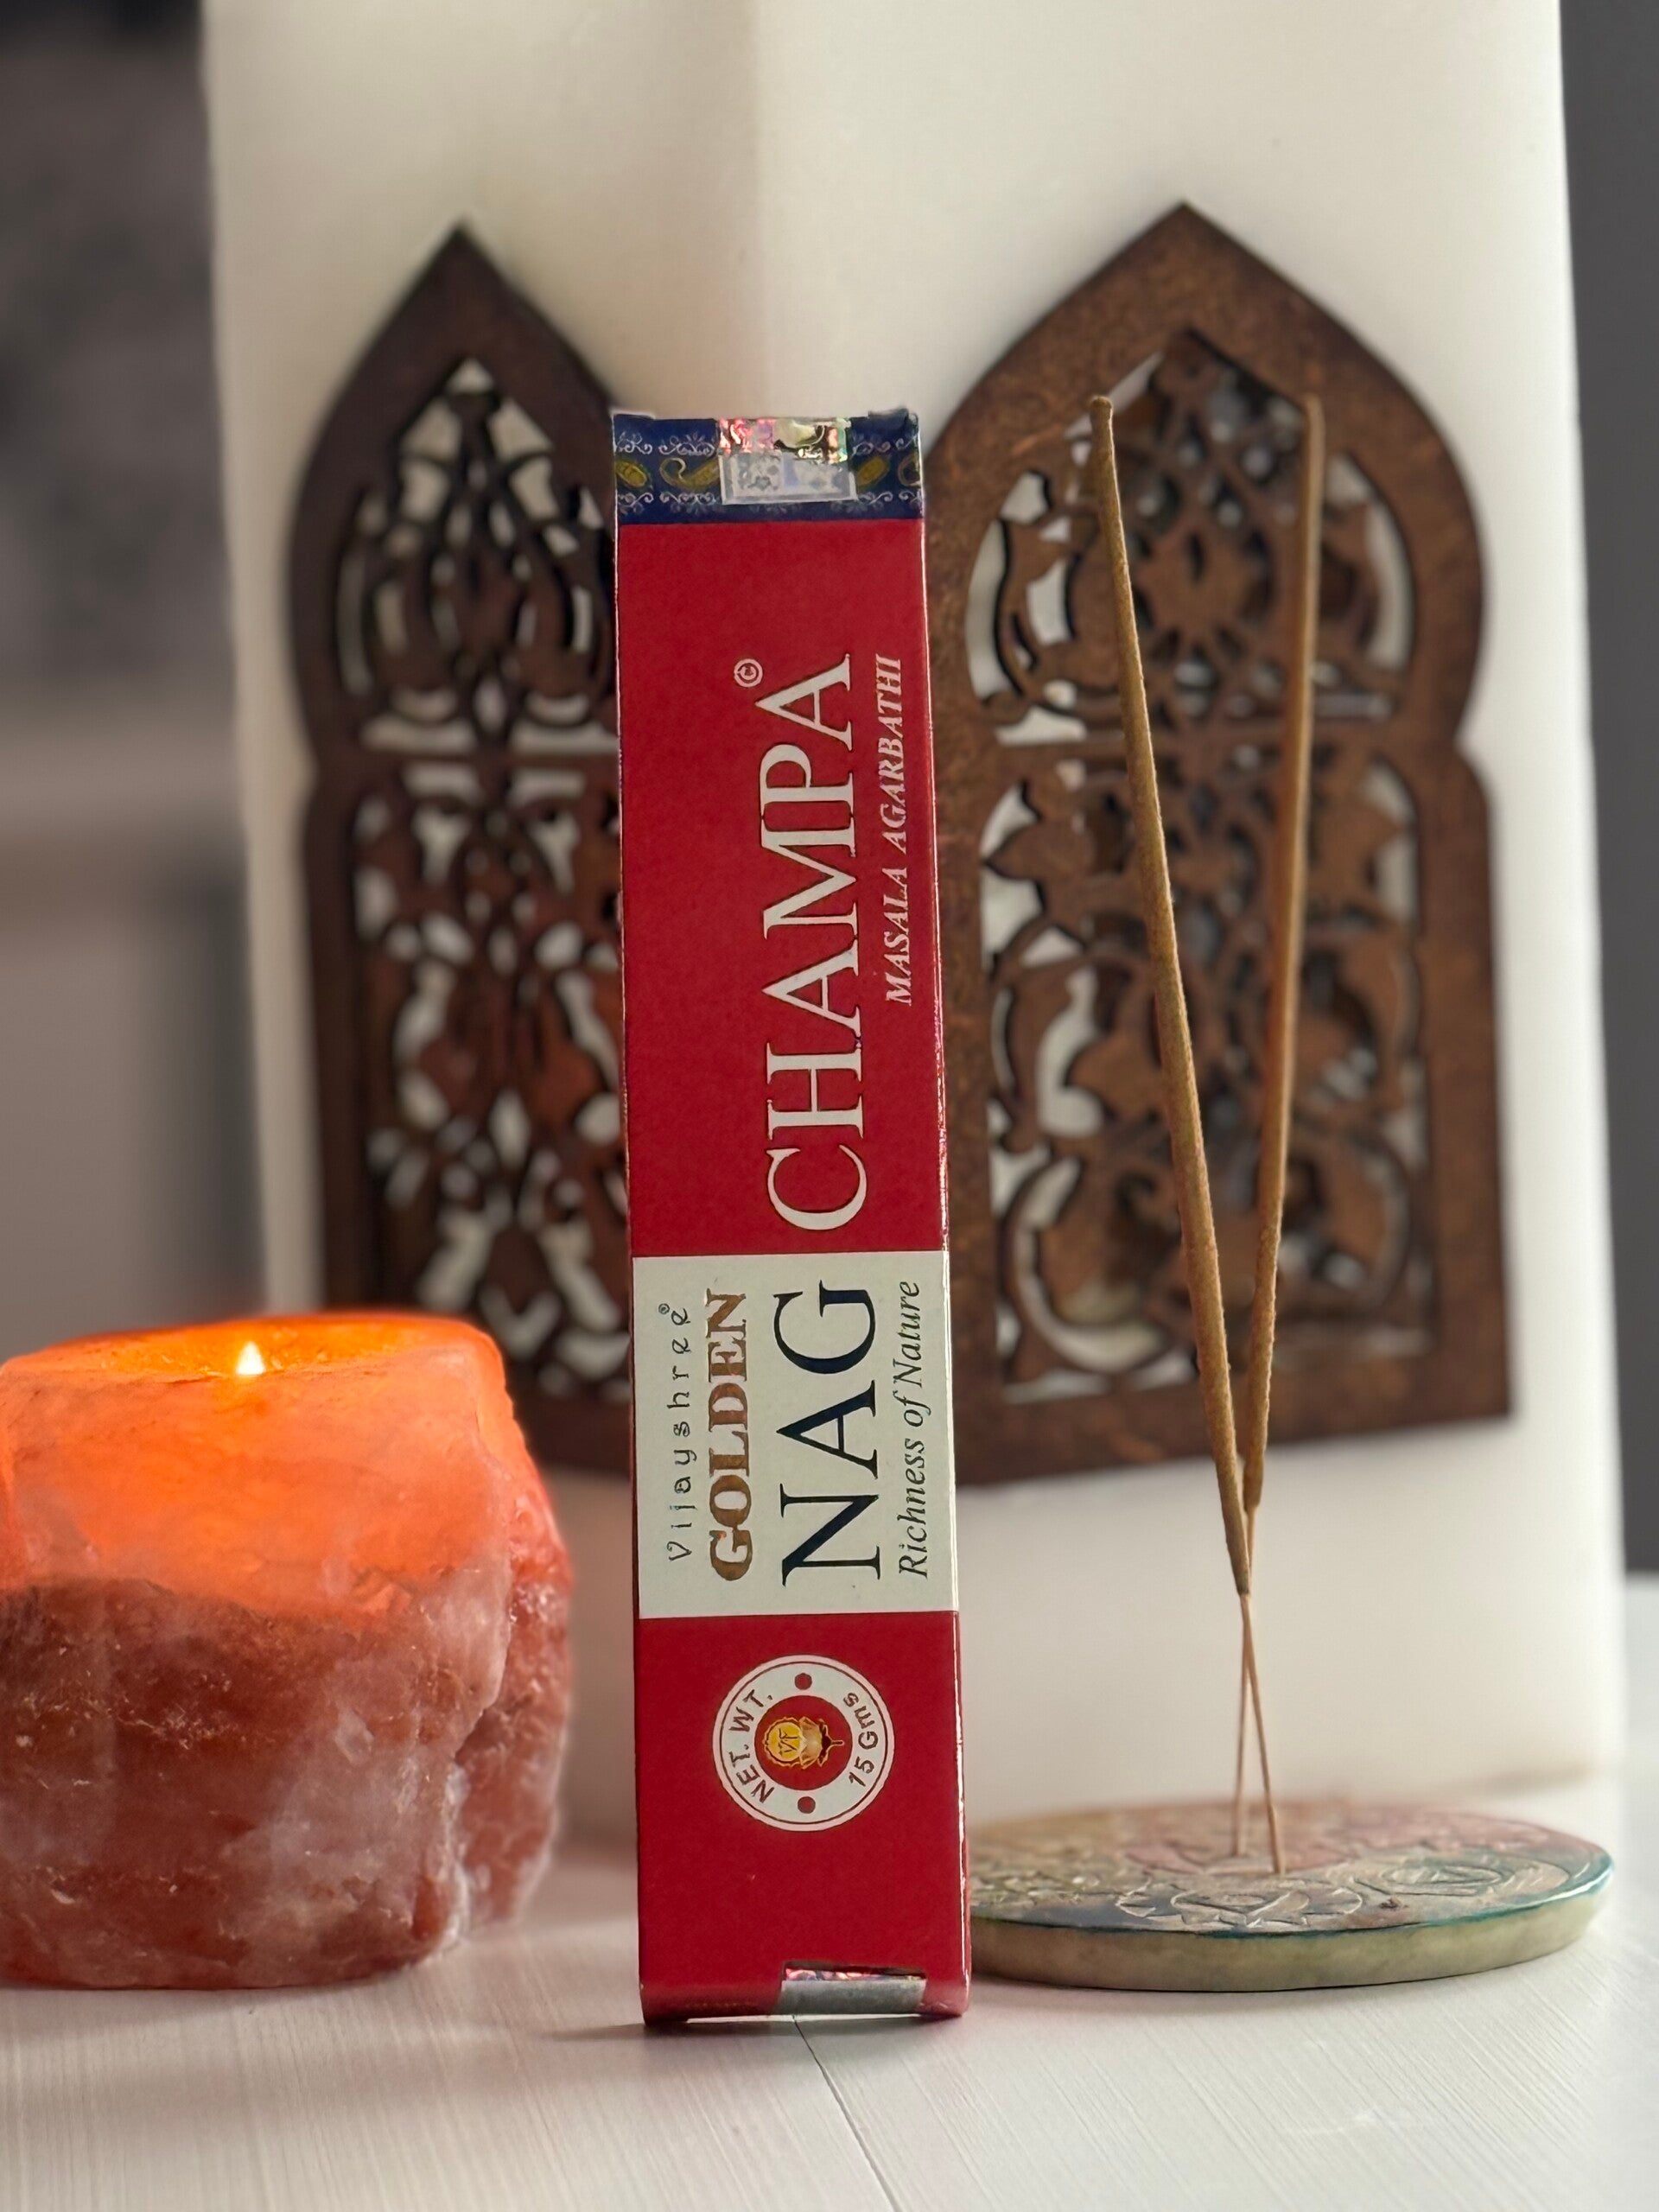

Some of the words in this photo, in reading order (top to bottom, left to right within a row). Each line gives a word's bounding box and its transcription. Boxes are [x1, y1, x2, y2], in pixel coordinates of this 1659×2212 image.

[874, 653, 908, 855] AGARBATHI
[883, 867, 912, 1007] MASALA
[893, 1281, 923, 1389] Nature
[704, 1287, 753, 1582] GOLDEN
[773, 1280, 880, 1586] NAG
[893, 1389, 931, 1427] of
[897, 1438, 928, 1579] Richness
[729, 1688, 773, 1733] WT.
[842, 1692, 879, 1750] Gms
[729, 1745, 775, 1803] NET.
[849, 1756, 874, 1788] 15
